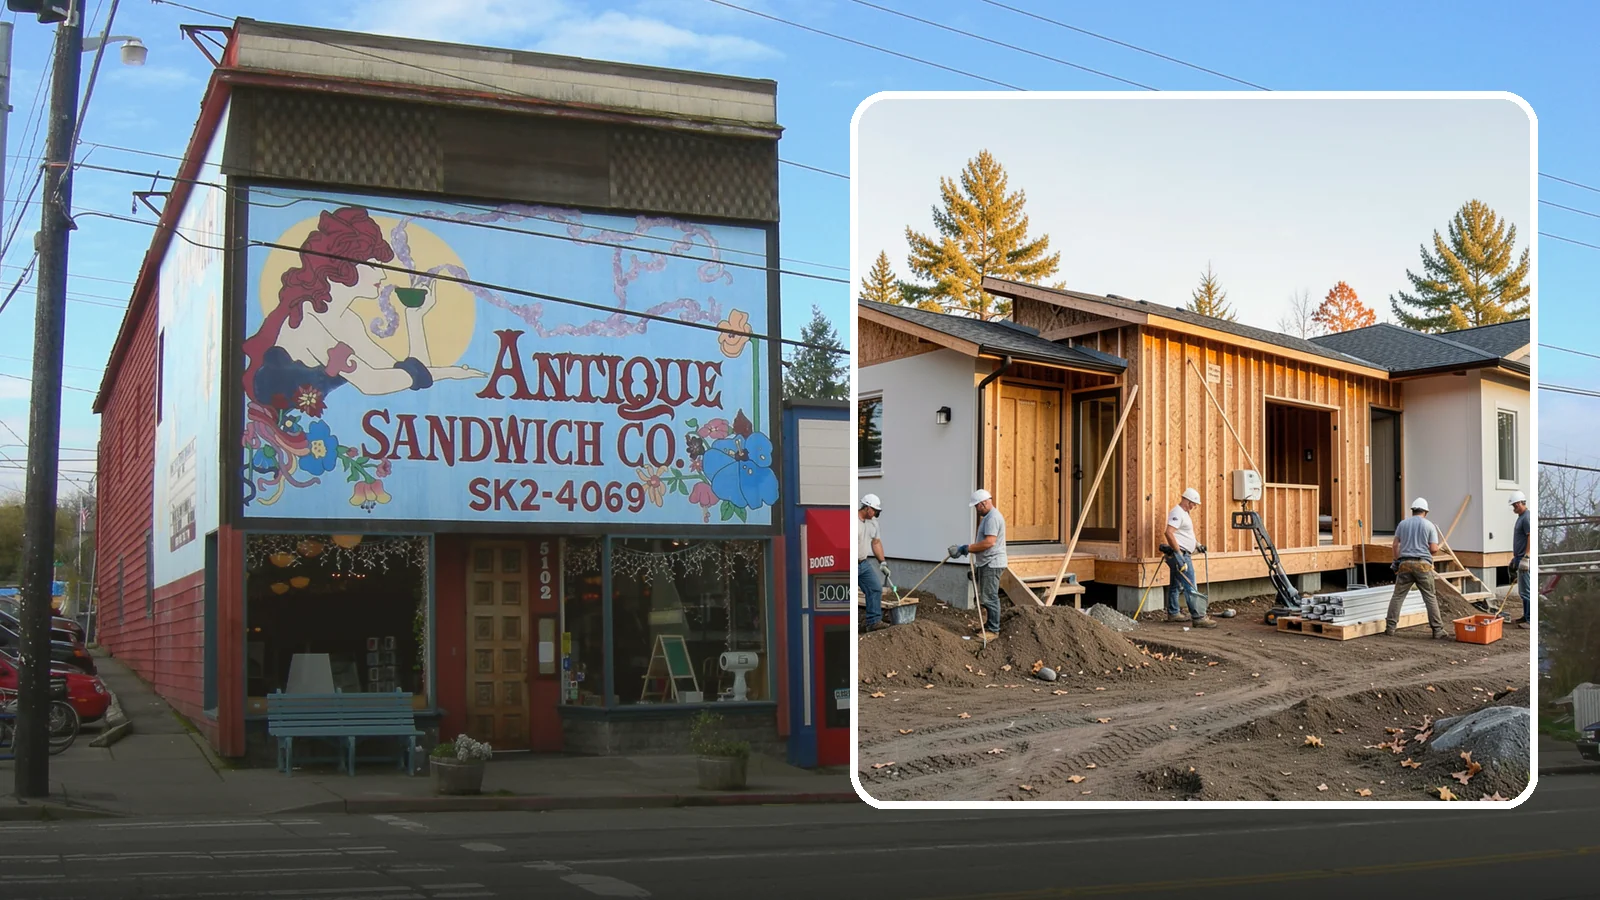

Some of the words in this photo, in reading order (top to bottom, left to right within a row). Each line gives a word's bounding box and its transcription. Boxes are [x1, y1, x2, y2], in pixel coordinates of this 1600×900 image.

[475, 328, 724, 421] ANTIQUE
[361, 408, 604, 467] SANDWICH
[616, 421, 685, 468] CO.
[468, 477, 646, 512] SK2-4069
[540, 541, 552, 600] 5102
[809, 555, 835, 569] BOOKS
